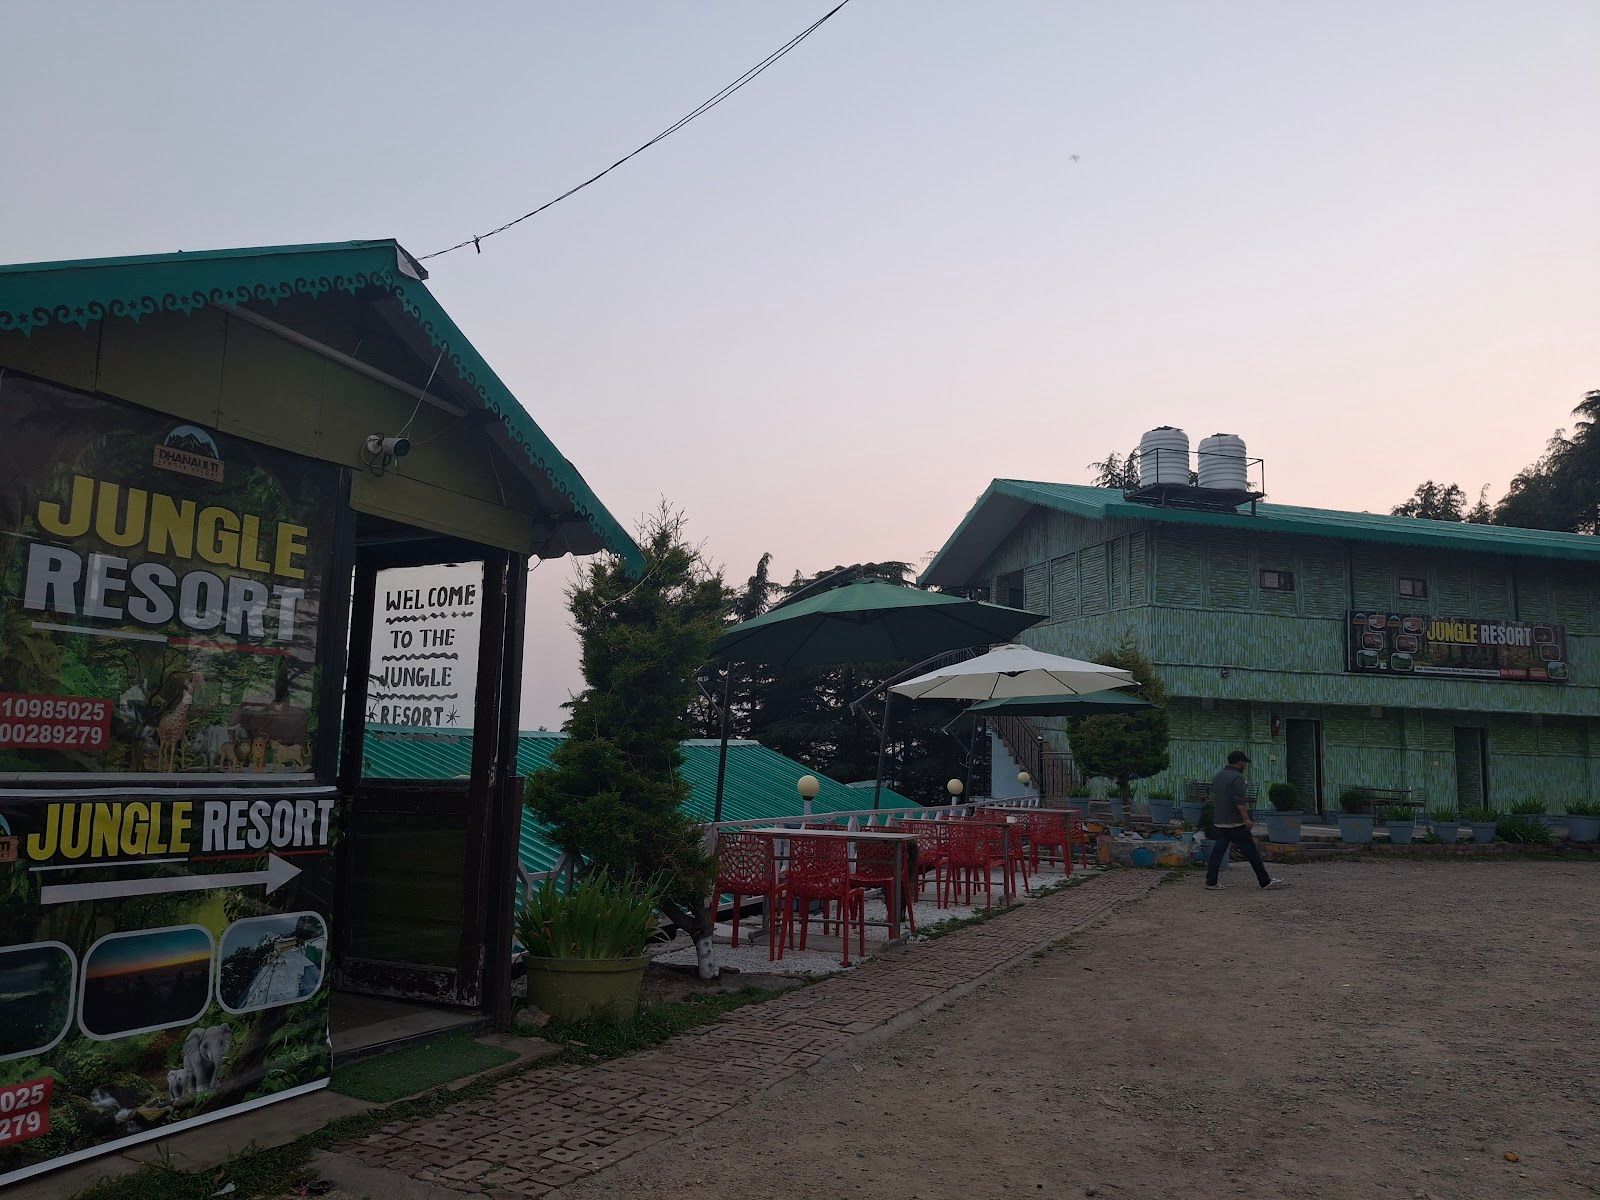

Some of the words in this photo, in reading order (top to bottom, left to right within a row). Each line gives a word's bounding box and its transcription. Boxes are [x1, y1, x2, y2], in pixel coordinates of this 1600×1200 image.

[38, 475, 308, 579] JUNGLE
[23, 542, 305, 641] RESORT
[385, 584, 476, 611] WELCOME
[390, 630, 413, 649] TO
[419, 628, 456, 648] THE
[1426, 621, 1478, 644] JUNGLE
[1480, 624, 1532, 647] RESORT
[380, 666, 453, 688] JUNGLE
[2, 698, 105, 721] 10985025
[380, 705, 444, 727] RESORT
[0, 723, 103, 745] 00289279
[26, 801, 193, 861] JUNGLE
[201, 800, 335, 852] RESORT
[0, 1083, 45, 1113] 025
[0, 1110, 41, 1141] 279
